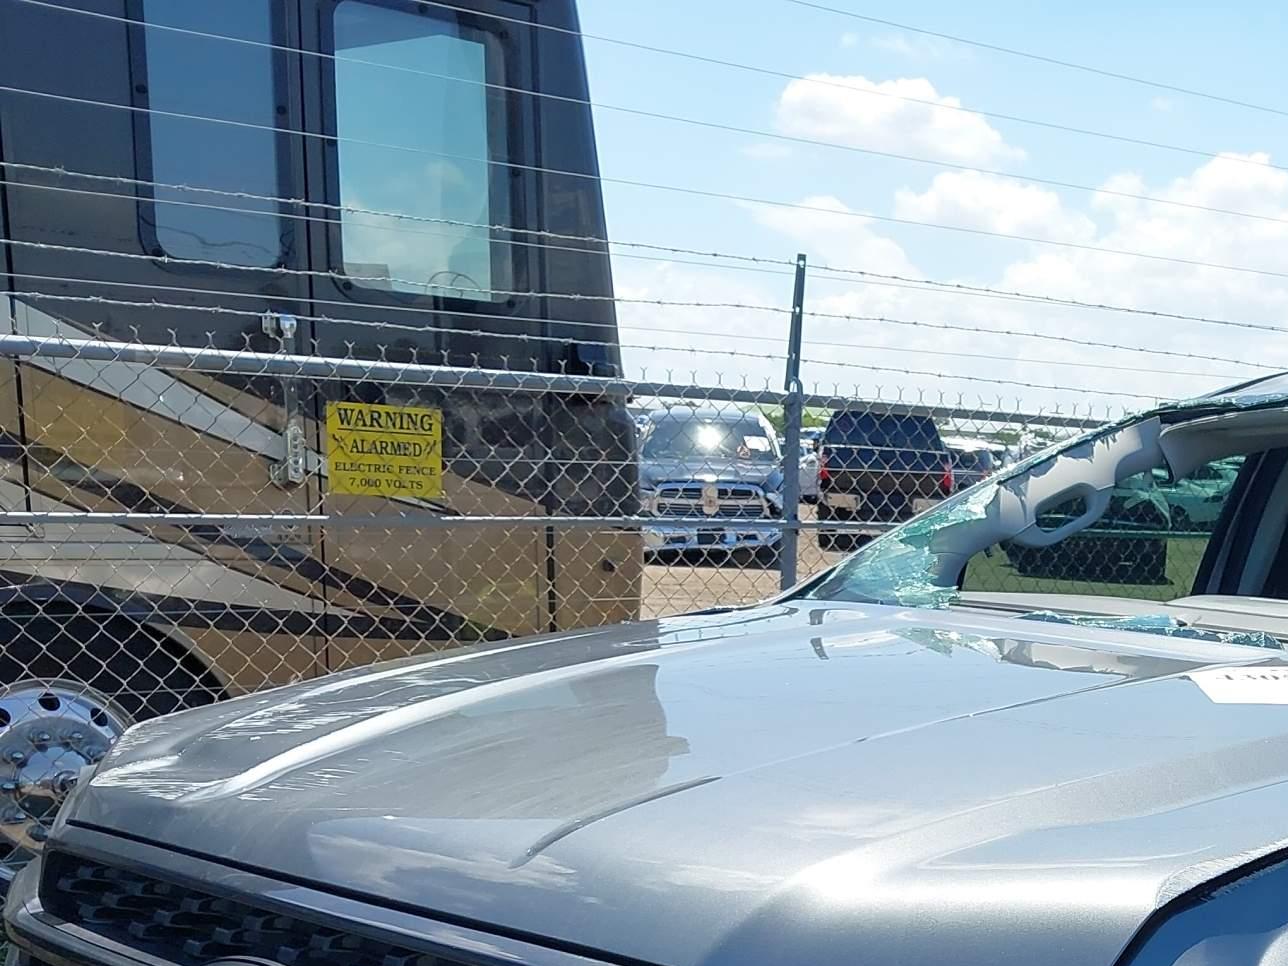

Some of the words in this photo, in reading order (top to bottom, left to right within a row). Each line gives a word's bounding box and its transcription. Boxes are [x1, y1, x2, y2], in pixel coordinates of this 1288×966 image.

[336, 408, 433, 432] WARNING
[349, 439, 422, 457] ALARMED
[335, 462, 394, 473] ELECTRIC
[398, 465, 436, 476] FENCE
[349, 477, 381, 488] 7,000
[385, 479, 423, 489] VOLTS
